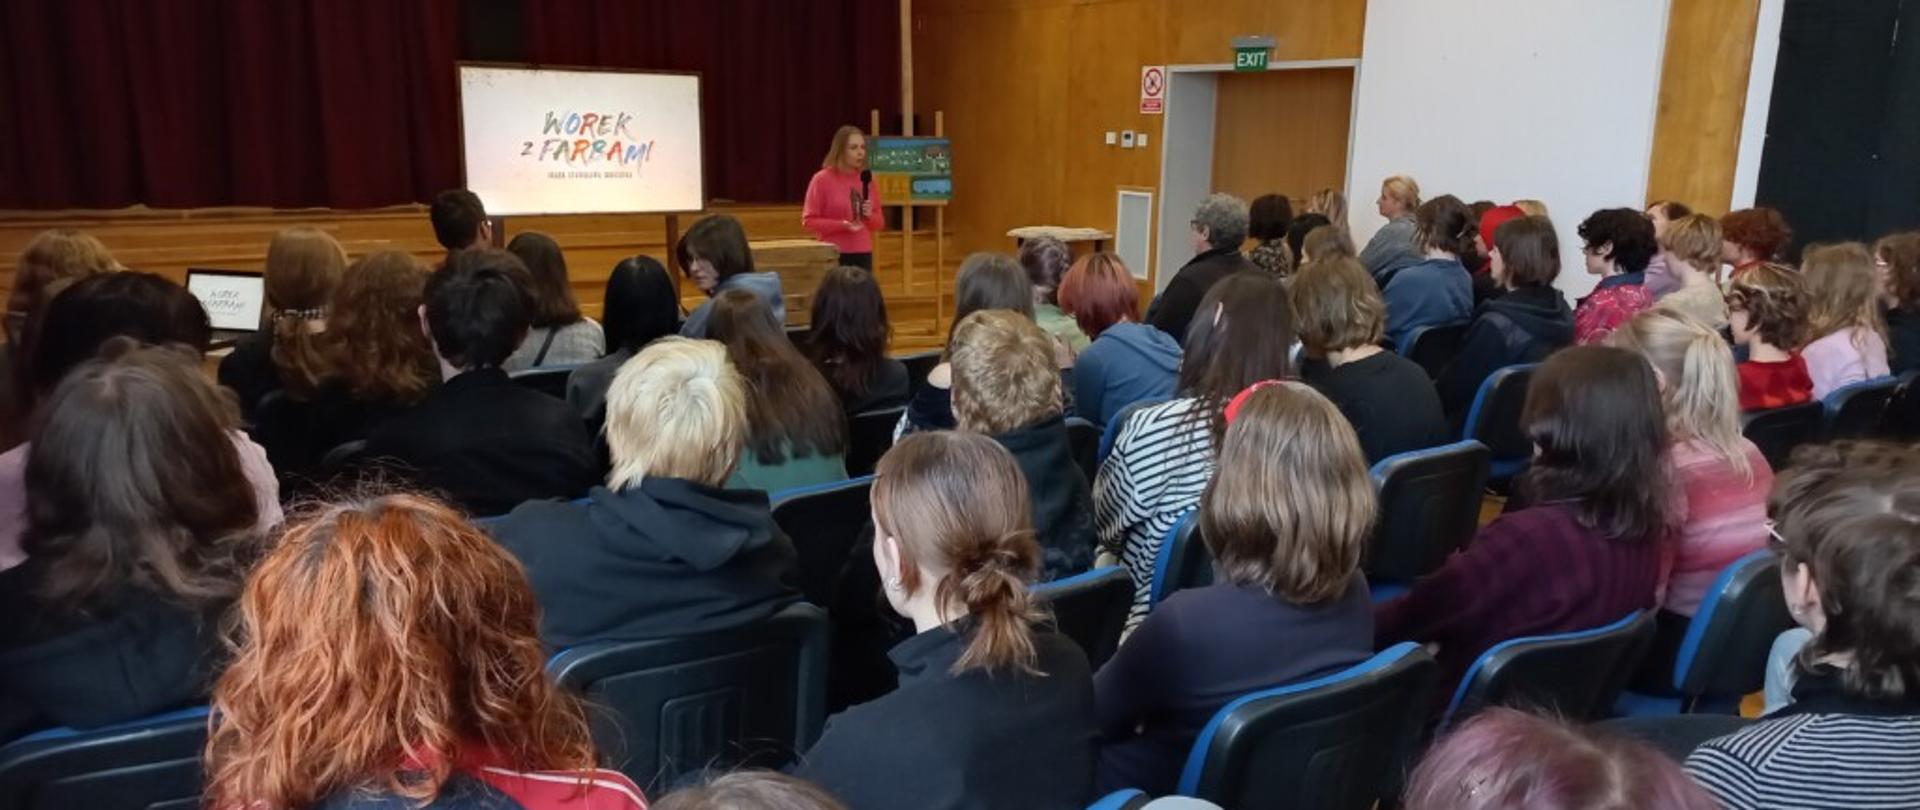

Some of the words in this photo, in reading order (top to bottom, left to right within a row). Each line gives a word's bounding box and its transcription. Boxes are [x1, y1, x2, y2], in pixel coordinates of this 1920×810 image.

[1237, 51, 1266, 67] EXIT
[542, 111, 633, 138] WOREK
[538, 139, 654, 167] FARBAMI
